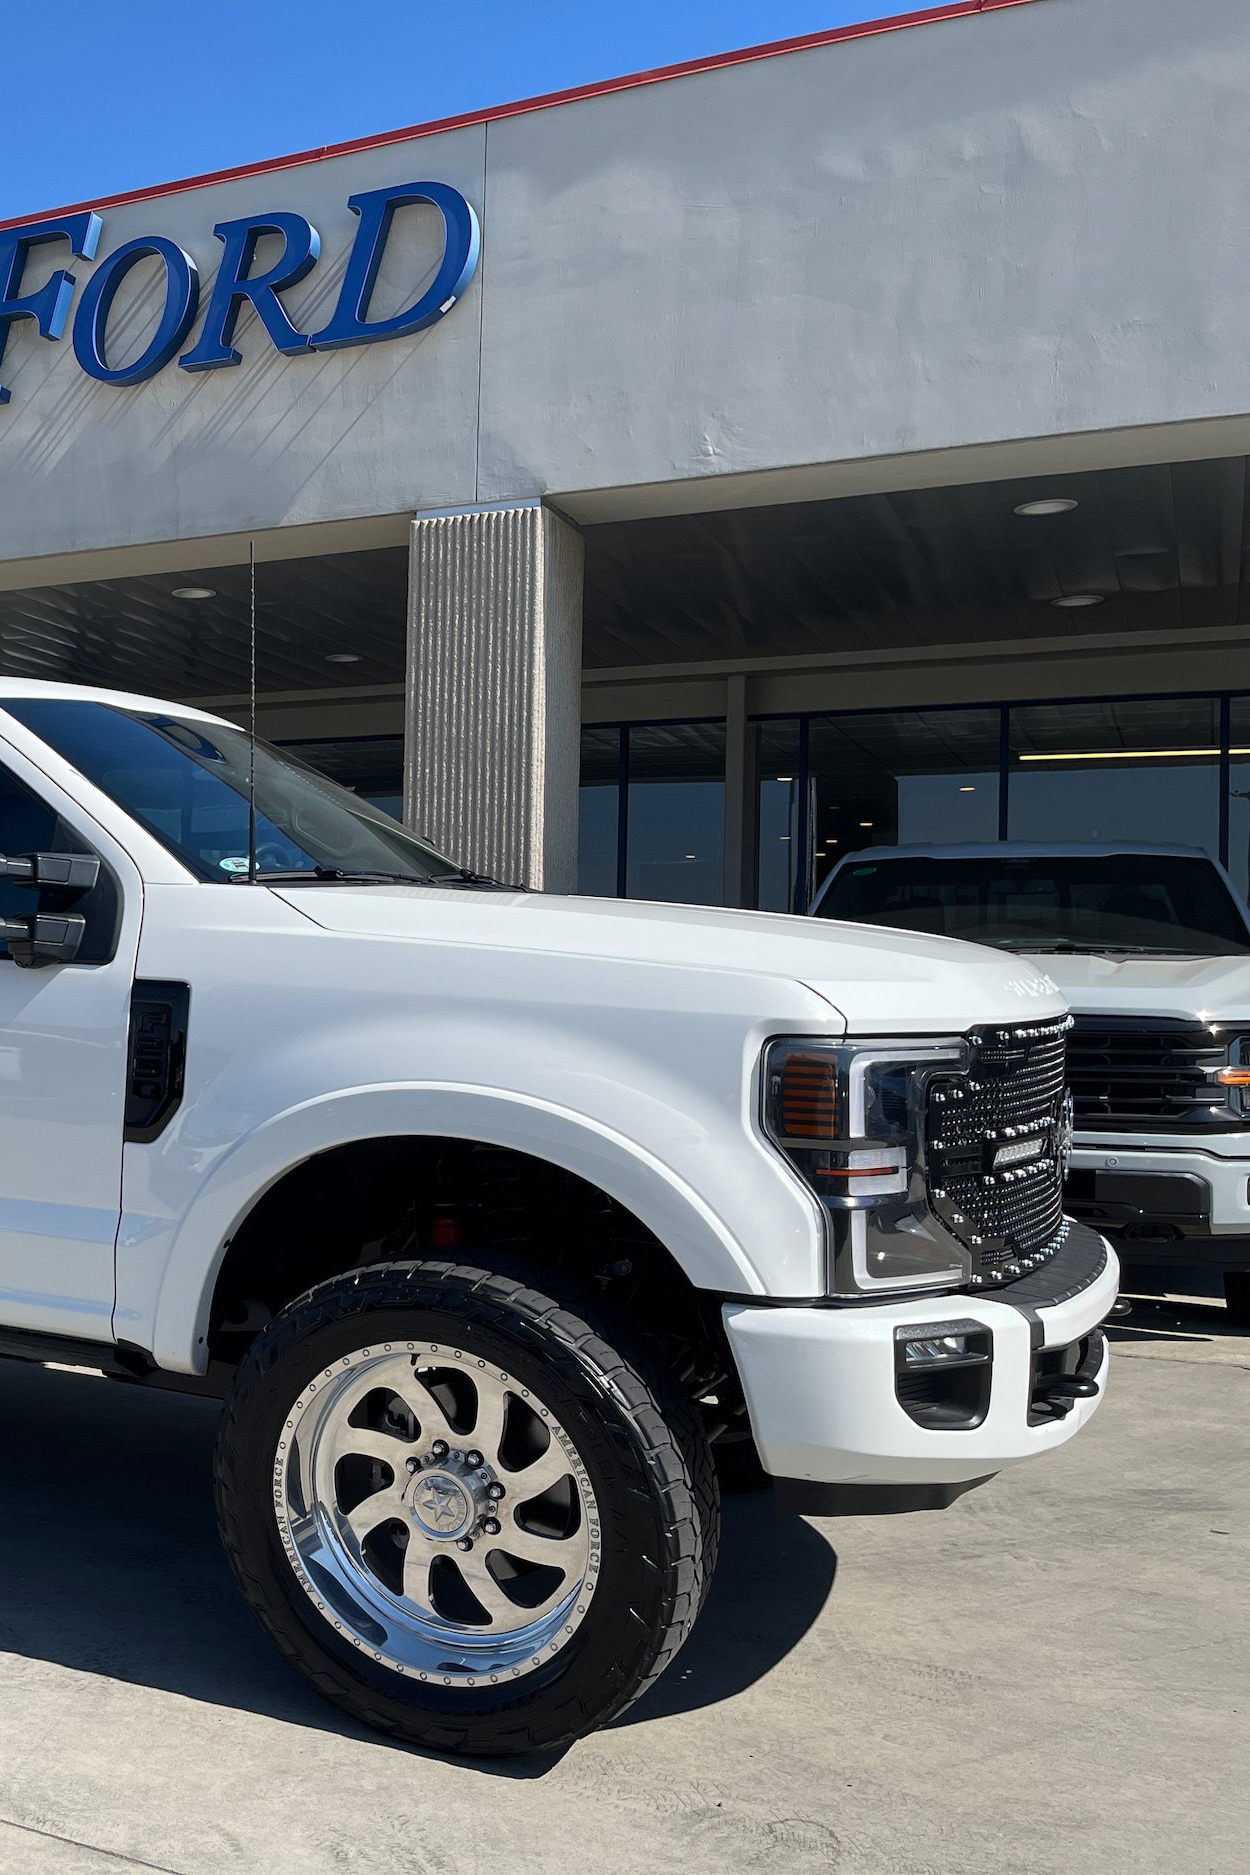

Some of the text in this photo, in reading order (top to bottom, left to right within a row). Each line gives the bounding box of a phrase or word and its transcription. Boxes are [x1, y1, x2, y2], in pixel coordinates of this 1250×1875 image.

[273, 1457, 315, 1594] AMERICAN FORCE
[551, 1425, 601, 1574] AMERICAN FORCE
